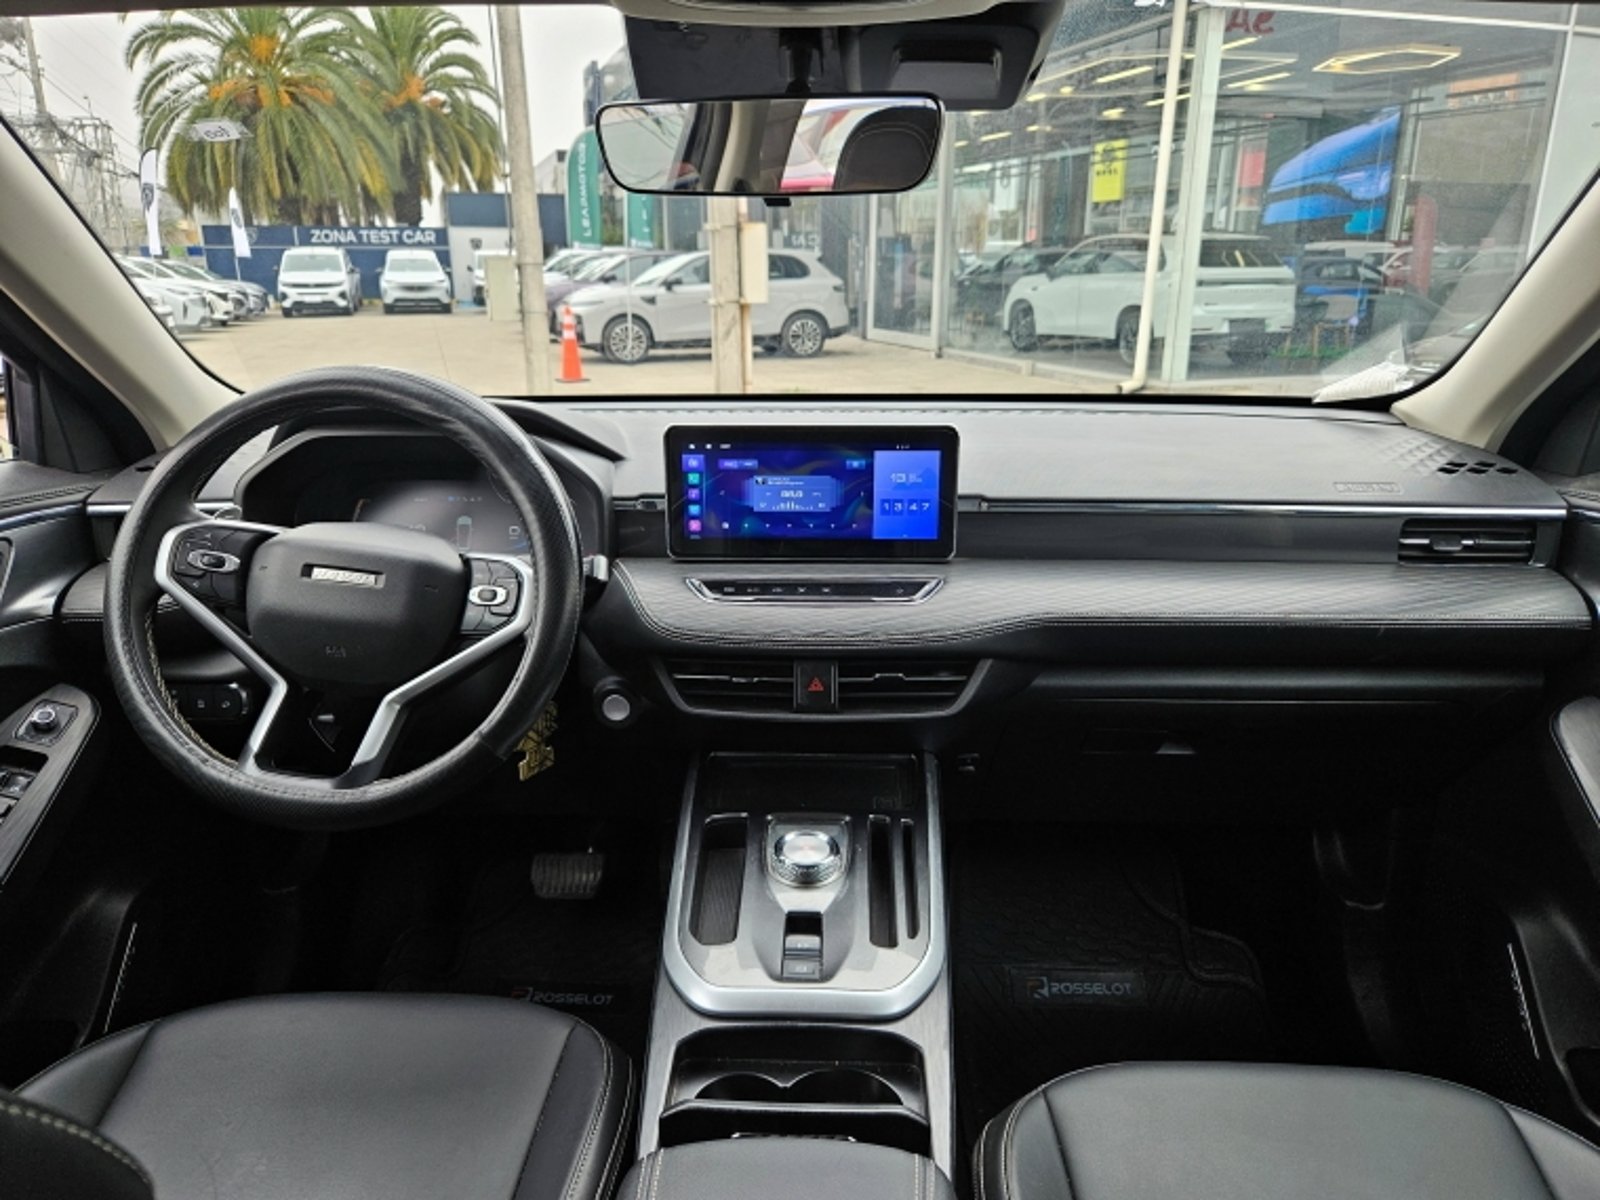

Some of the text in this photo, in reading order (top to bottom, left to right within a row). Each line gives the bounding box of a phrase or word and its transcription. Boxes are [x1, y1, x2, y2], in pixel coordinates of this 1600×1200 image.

[310, 229, 436, 245] ZONA TEST CAR
[1050, 982, 1132, 995] ROSSELOT
[534, 991, 613, 1005] ROSSELOT
